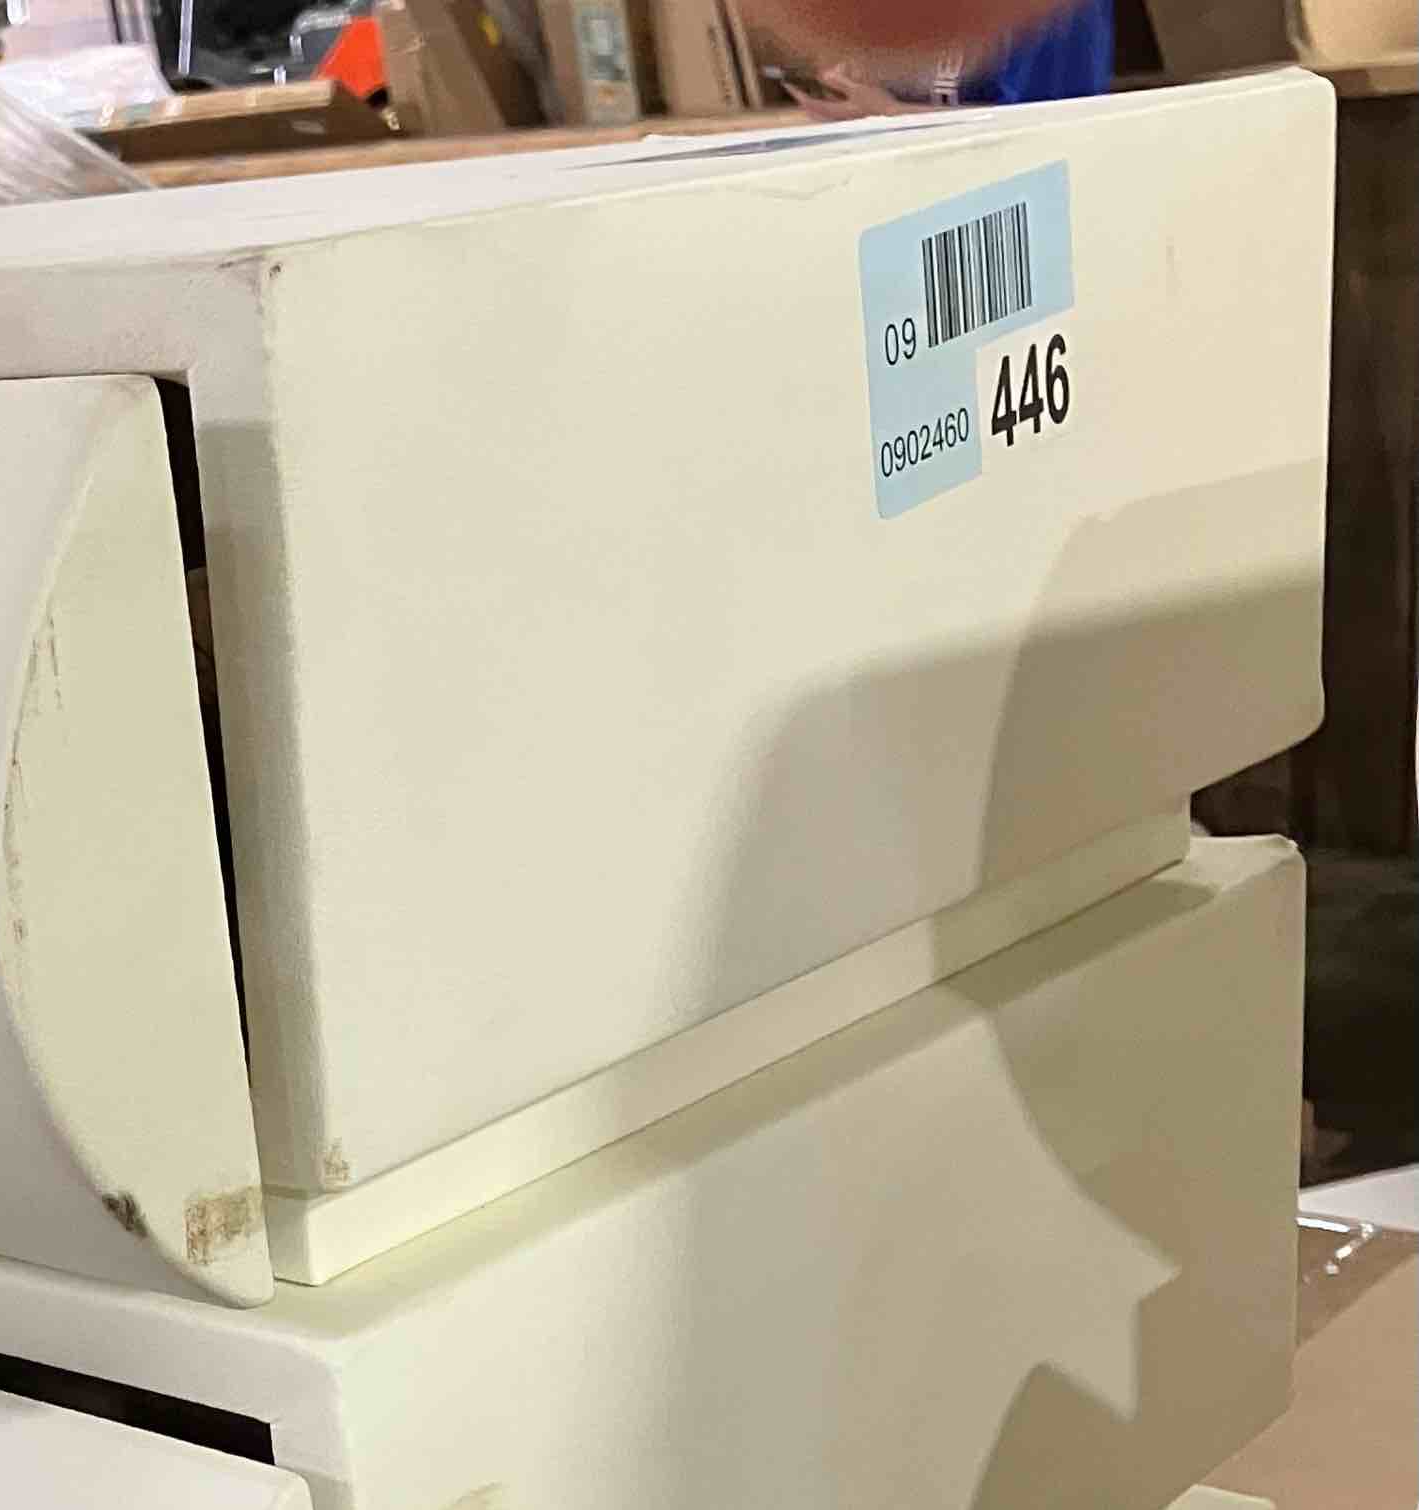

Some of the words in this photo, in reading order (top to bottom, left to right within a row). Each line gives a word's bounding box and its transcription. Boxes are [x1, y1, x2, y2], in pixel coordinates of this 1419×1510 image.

[885, 317, 917, 366] 09
[991, 333, 1070, 447] 446
[881, 407, 970, 478] 0902460
